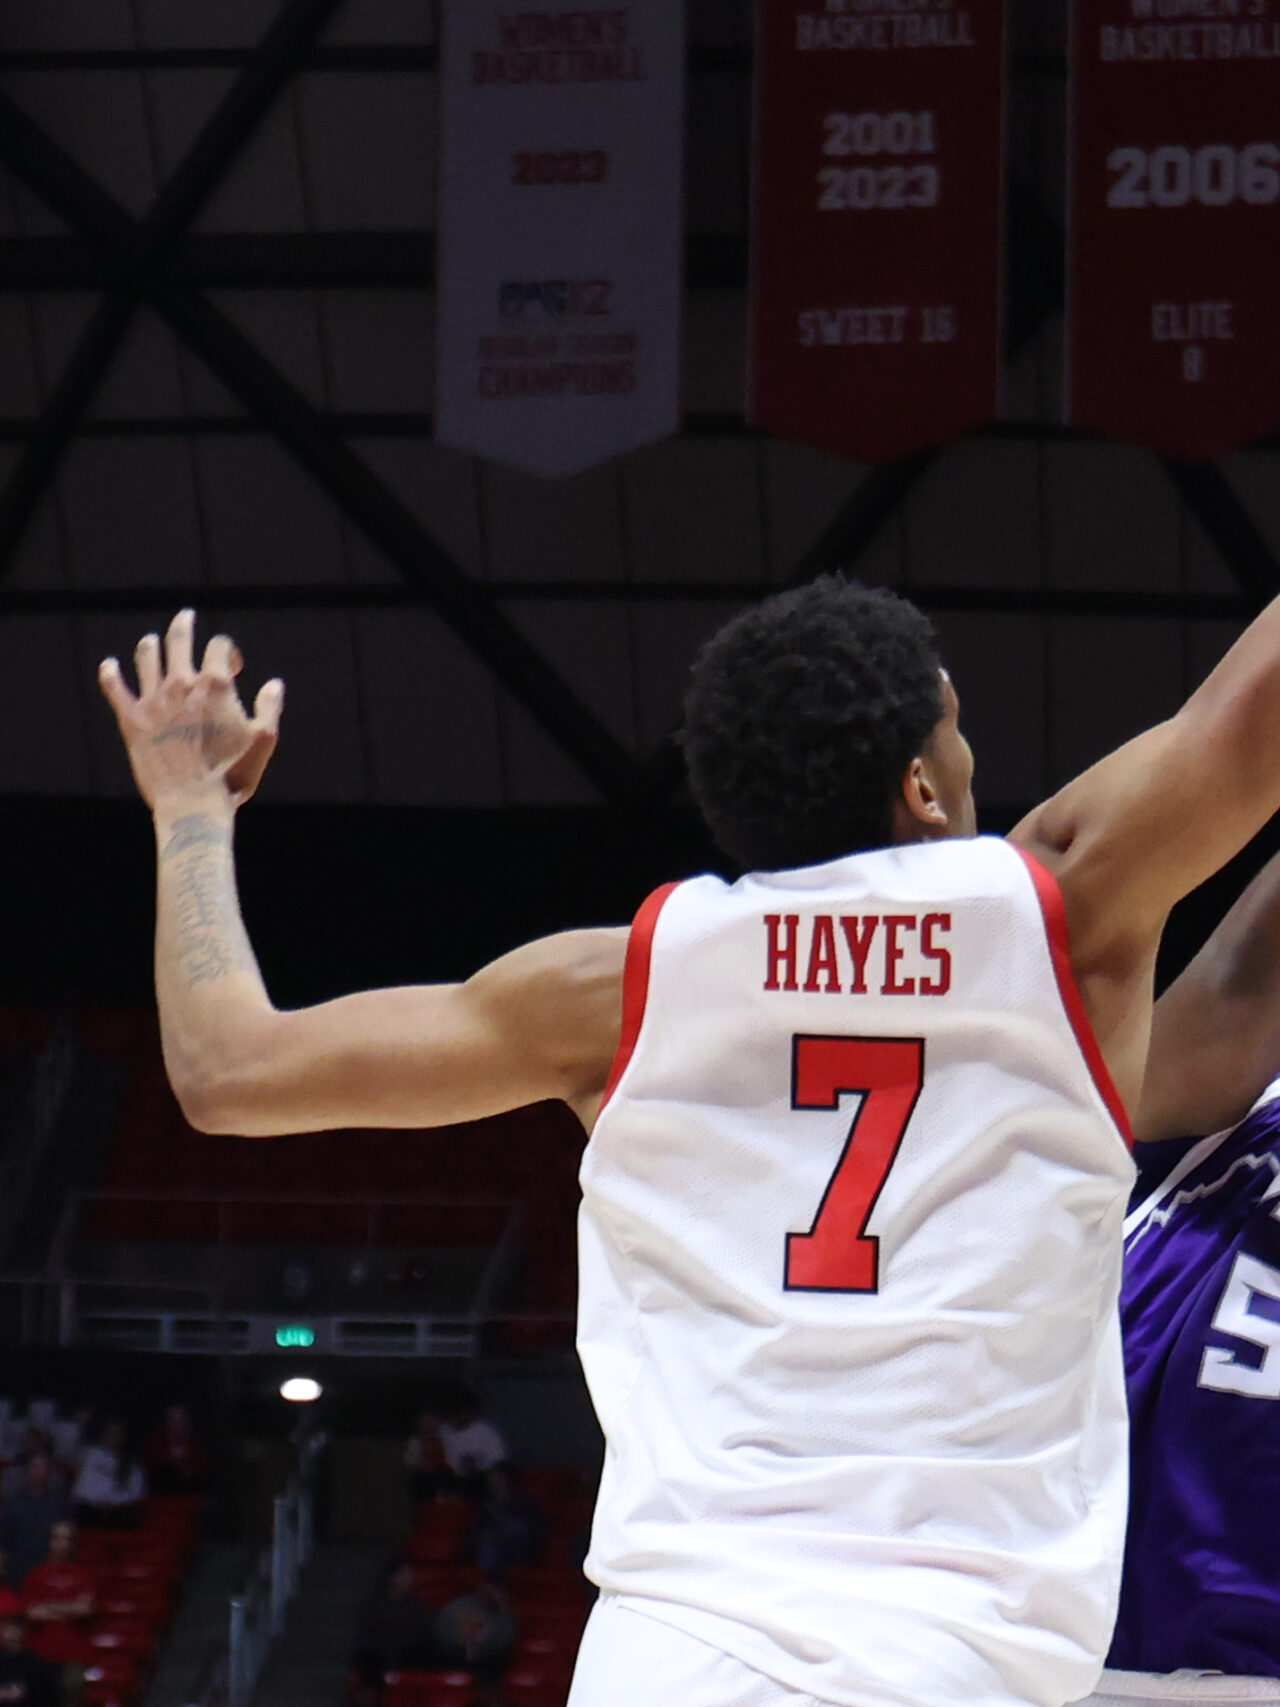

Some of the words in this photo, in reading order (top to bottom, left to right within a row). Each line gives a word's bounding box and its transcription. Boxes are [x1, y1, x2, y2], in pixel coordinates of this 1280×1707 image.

[796, 11, 976, 50] BASKETBALL
[472, 48, 648, 86] BASKETBALL
[822, 110, 937, 156] 2001
[513, 150, 608, 186] 2023
[817, 164, 940, 211] 2023
[798, 306, 909, 347] SWEET
[920, 305, 957, 344] 16
[1152, 302, 1234, 341] ELITE
[763, 913, 952, 996] HAYES
[784, 1033, 926, 1295] 7
